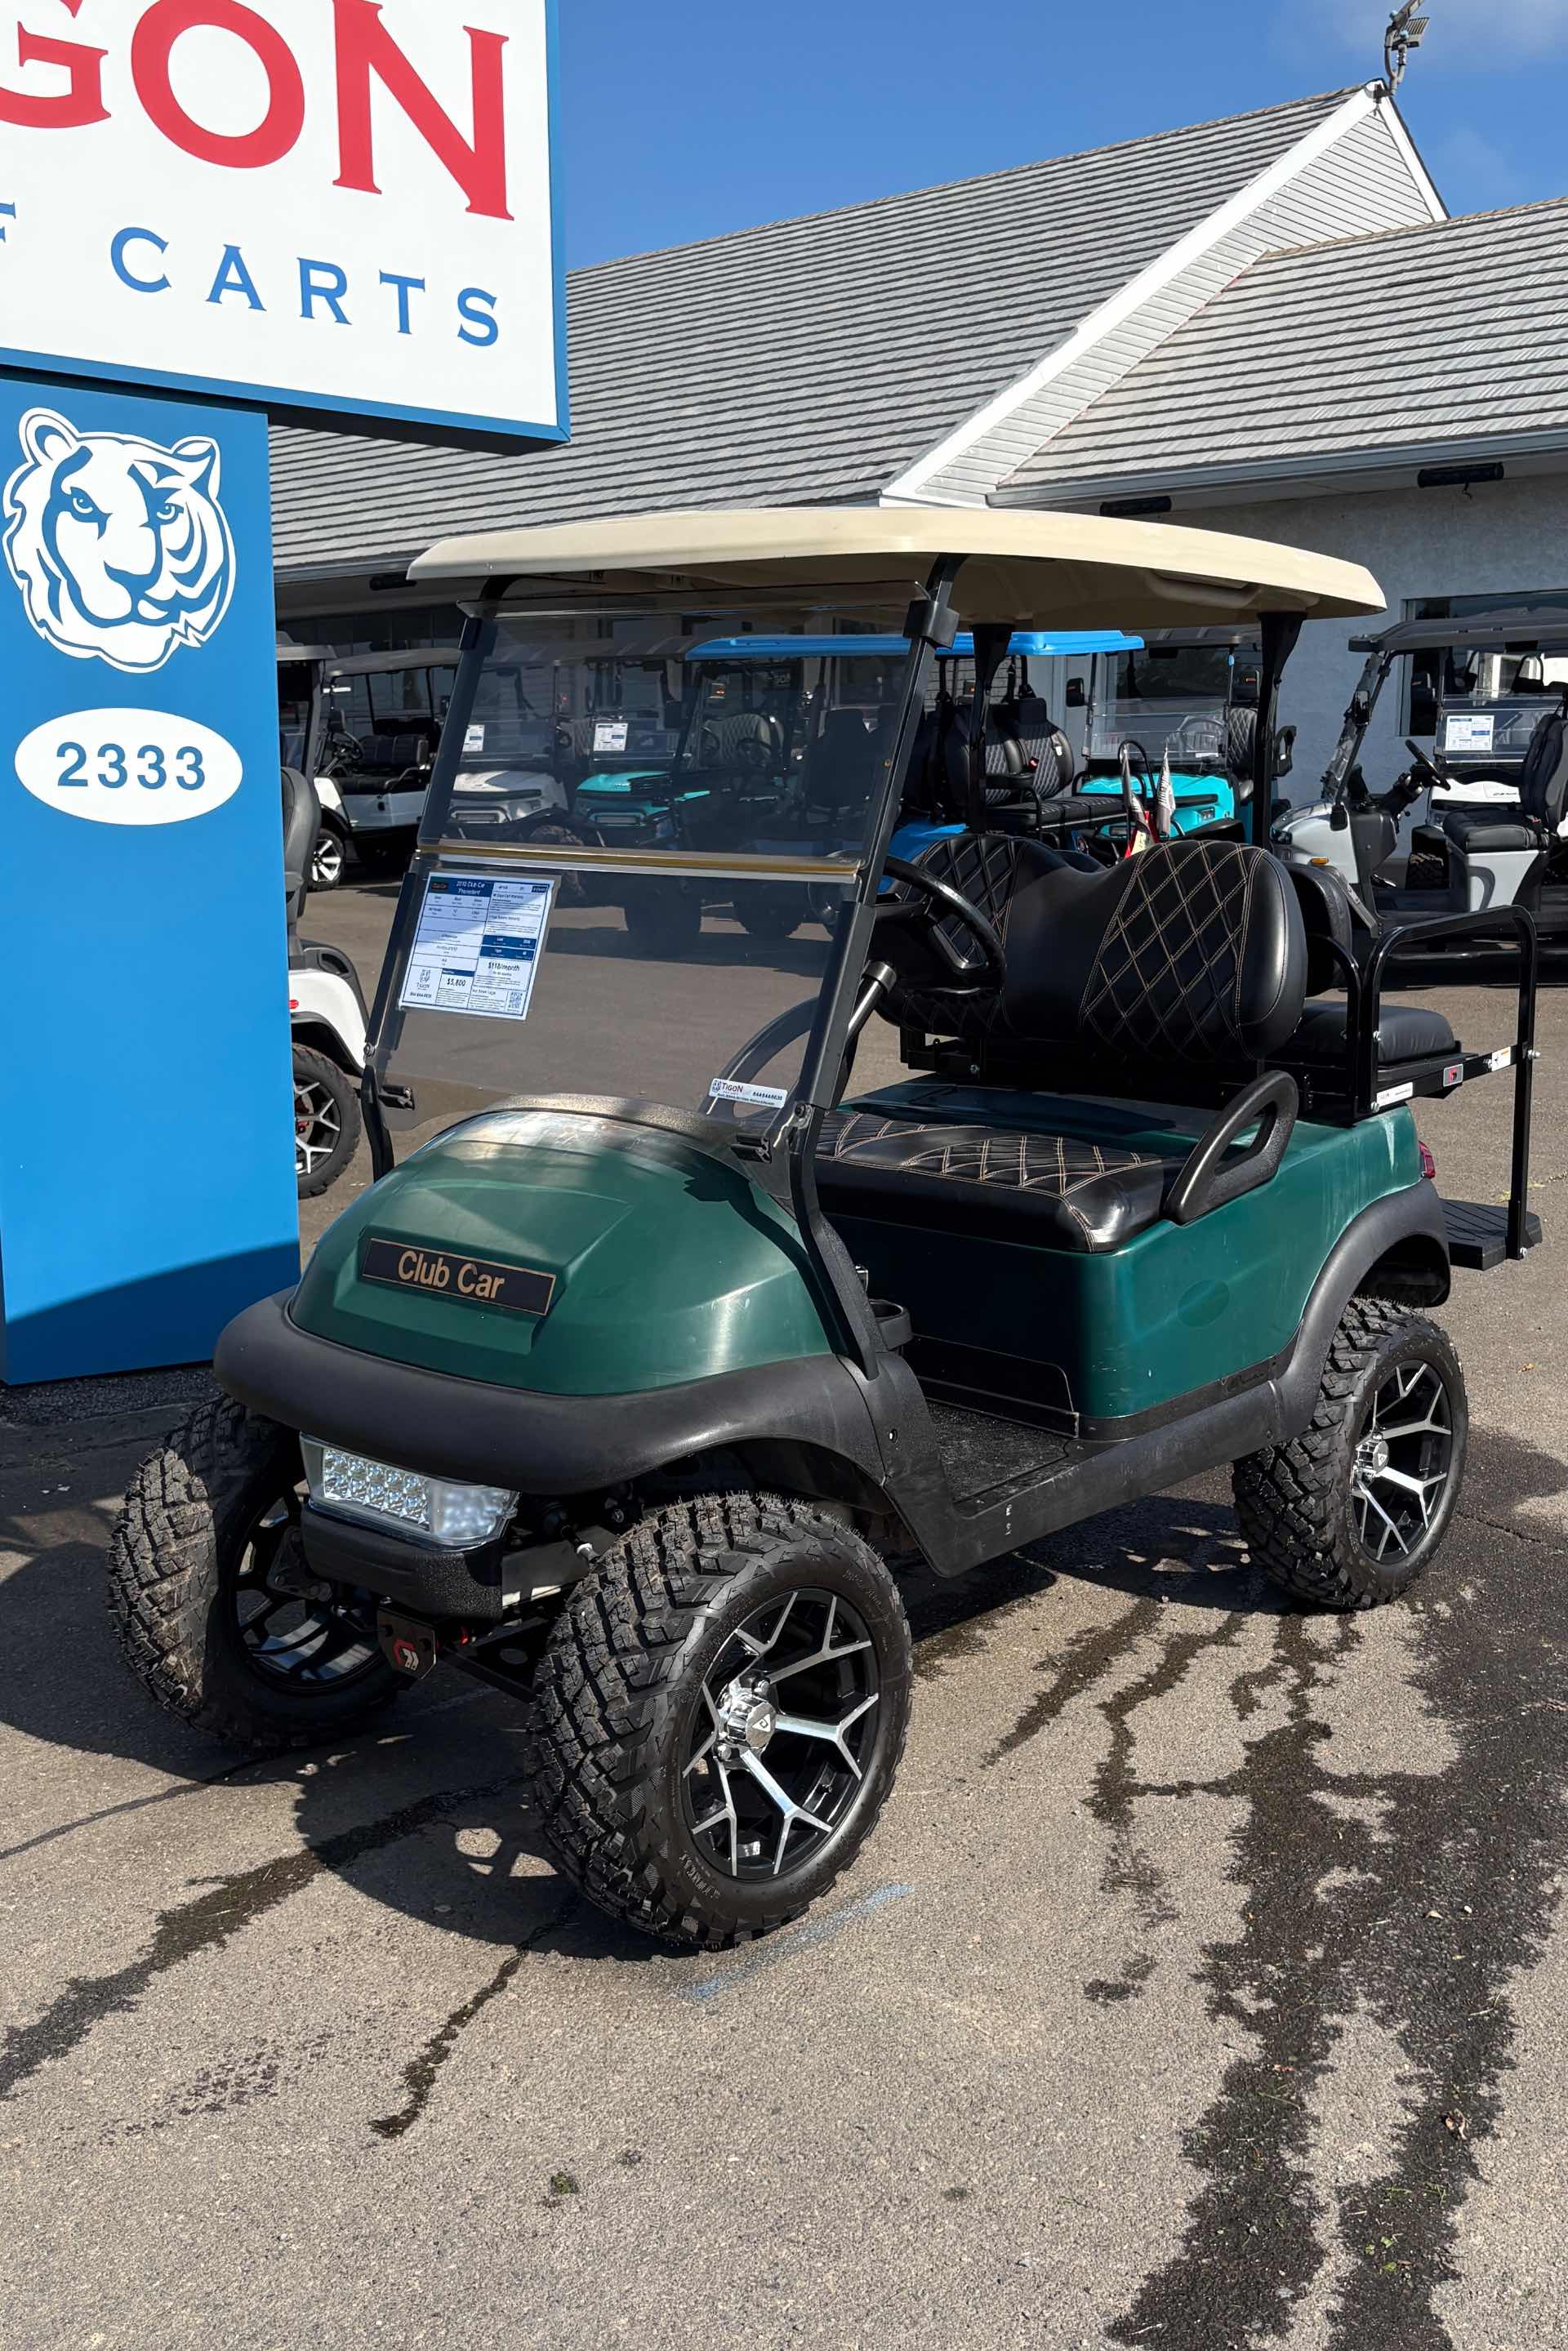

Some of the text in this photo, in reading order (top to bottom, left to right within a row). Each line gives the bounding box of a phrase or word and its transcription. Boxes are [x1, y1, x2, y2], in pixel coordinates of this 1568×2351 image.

[110, 227, 499, 347] CARTS
[56, 741, 206, 790] 2333
[722, 1082, 744, 1093] TIGON
[398, 1250, 506, 1299] Club Car
